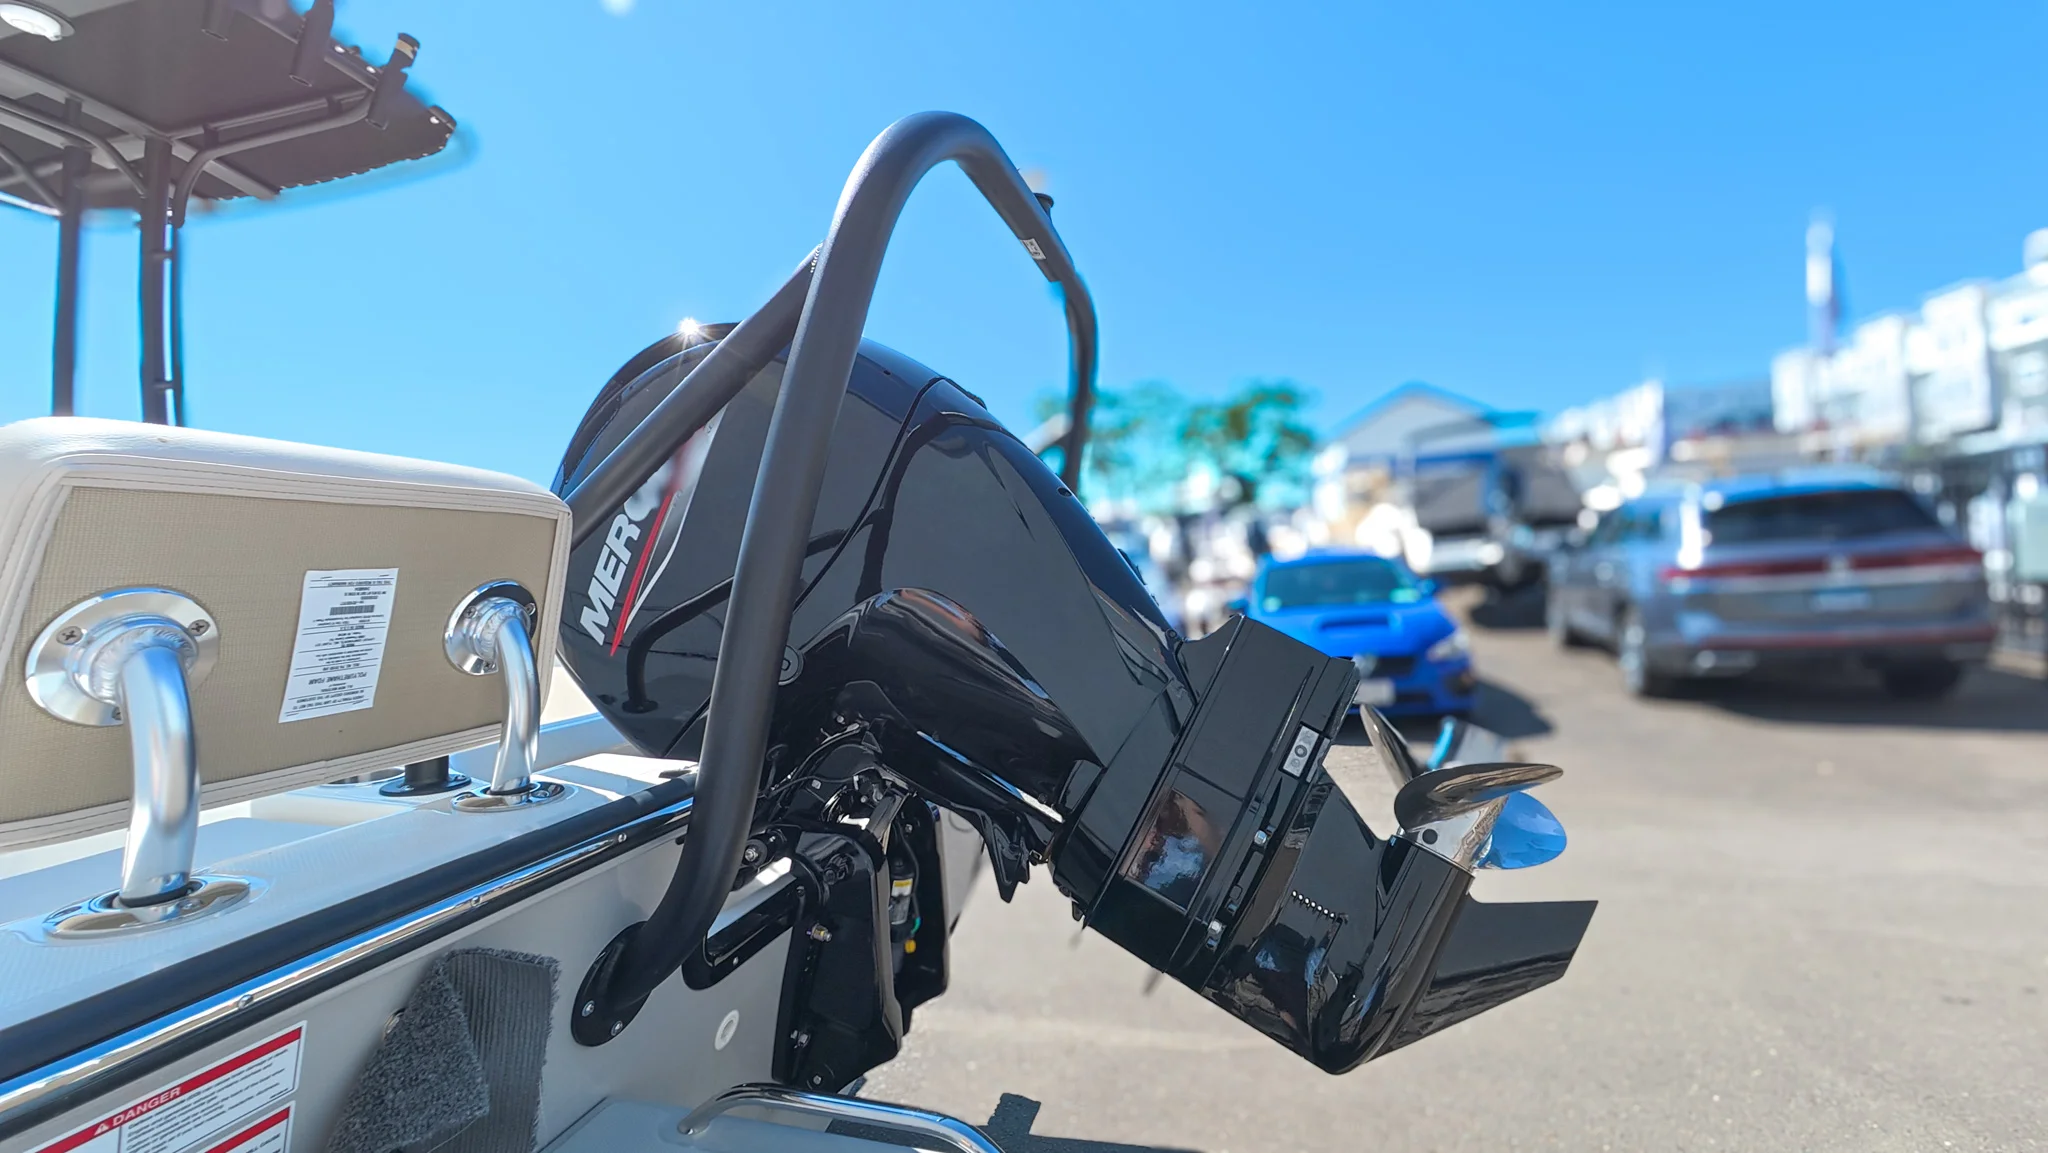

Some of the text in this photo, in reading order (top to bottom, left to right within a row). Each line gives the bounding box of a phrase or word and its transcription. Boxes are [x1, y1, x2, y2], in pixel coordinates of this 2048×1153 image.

[307, 671, 367, 684] POLYURETHANE FOAM
[112, 1087, 182, 1127] DANGER
